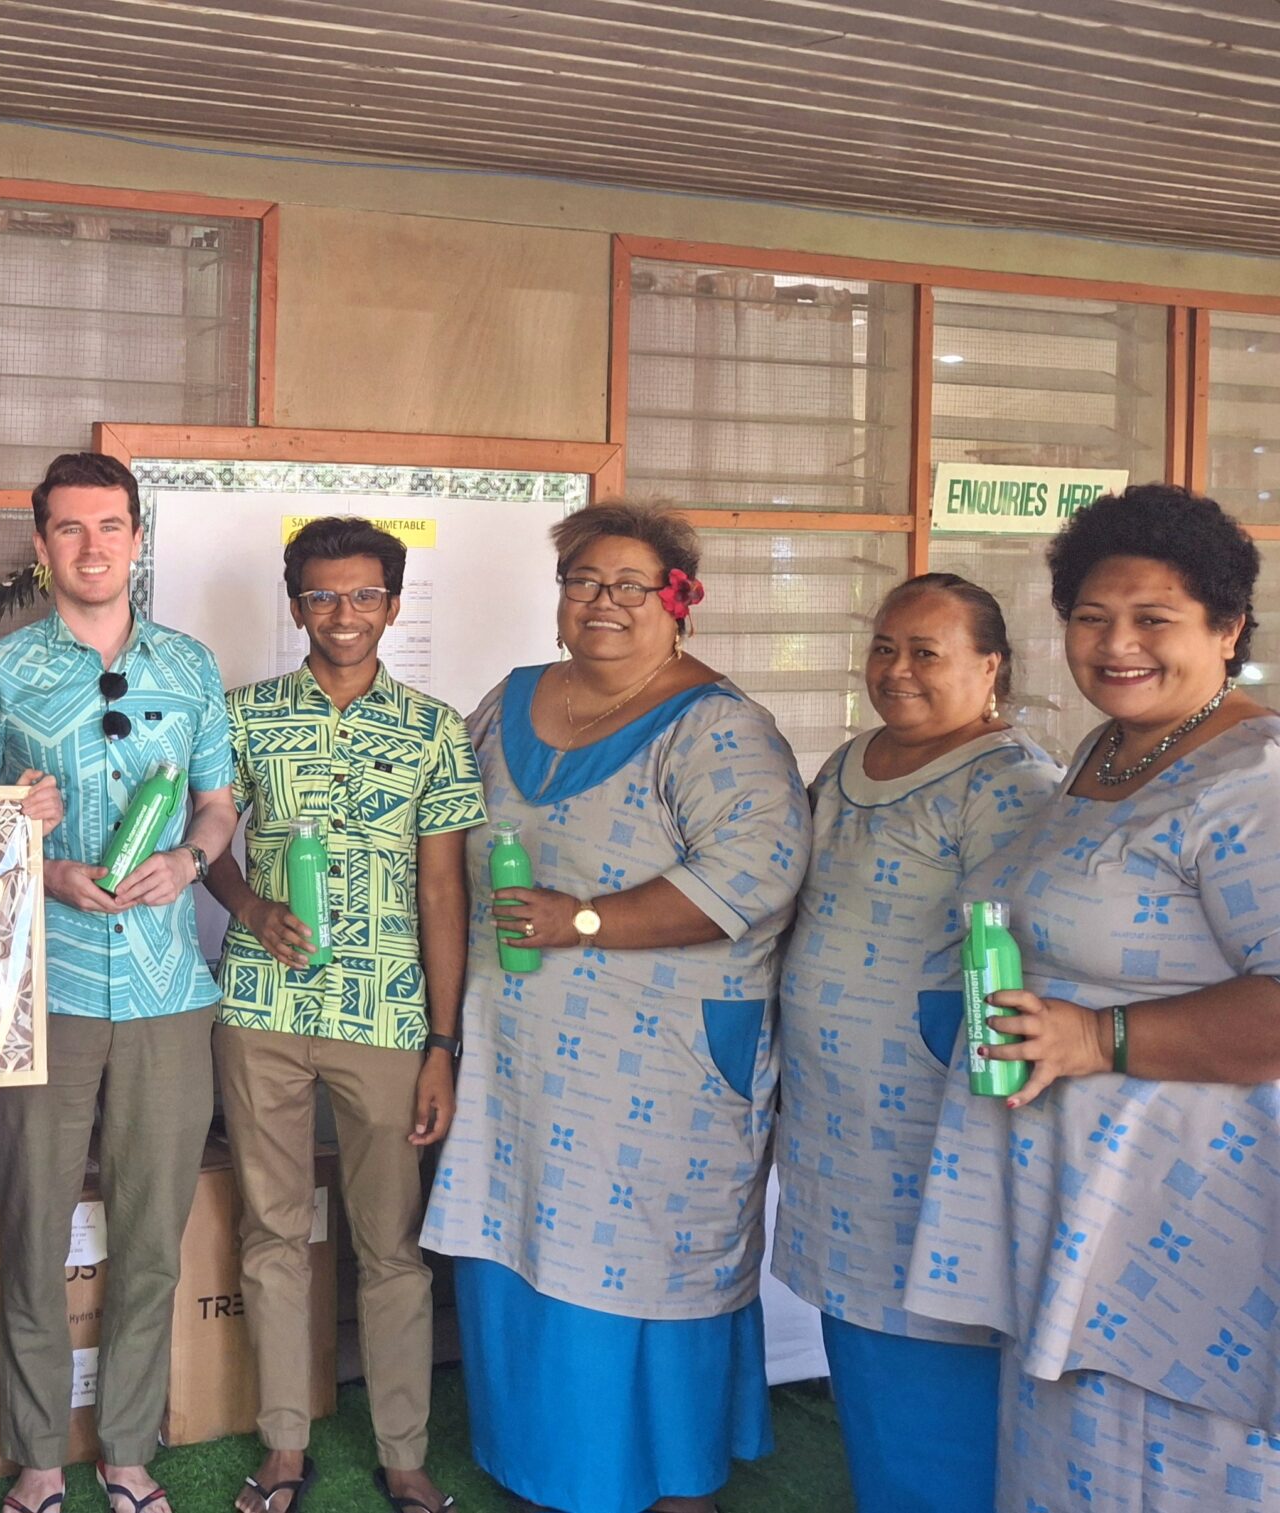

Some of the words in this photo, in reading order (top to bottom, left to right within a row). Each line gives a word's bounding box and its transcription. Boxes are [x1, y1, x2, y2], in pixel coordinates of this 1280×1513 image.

[947, 479, 1048, 517] ENQUIRIES
[375, 519, 426, 531] TIMETABLE
[970, 969, 984, 1040] Development
[69, 1312, 94, 1325] Hydro
